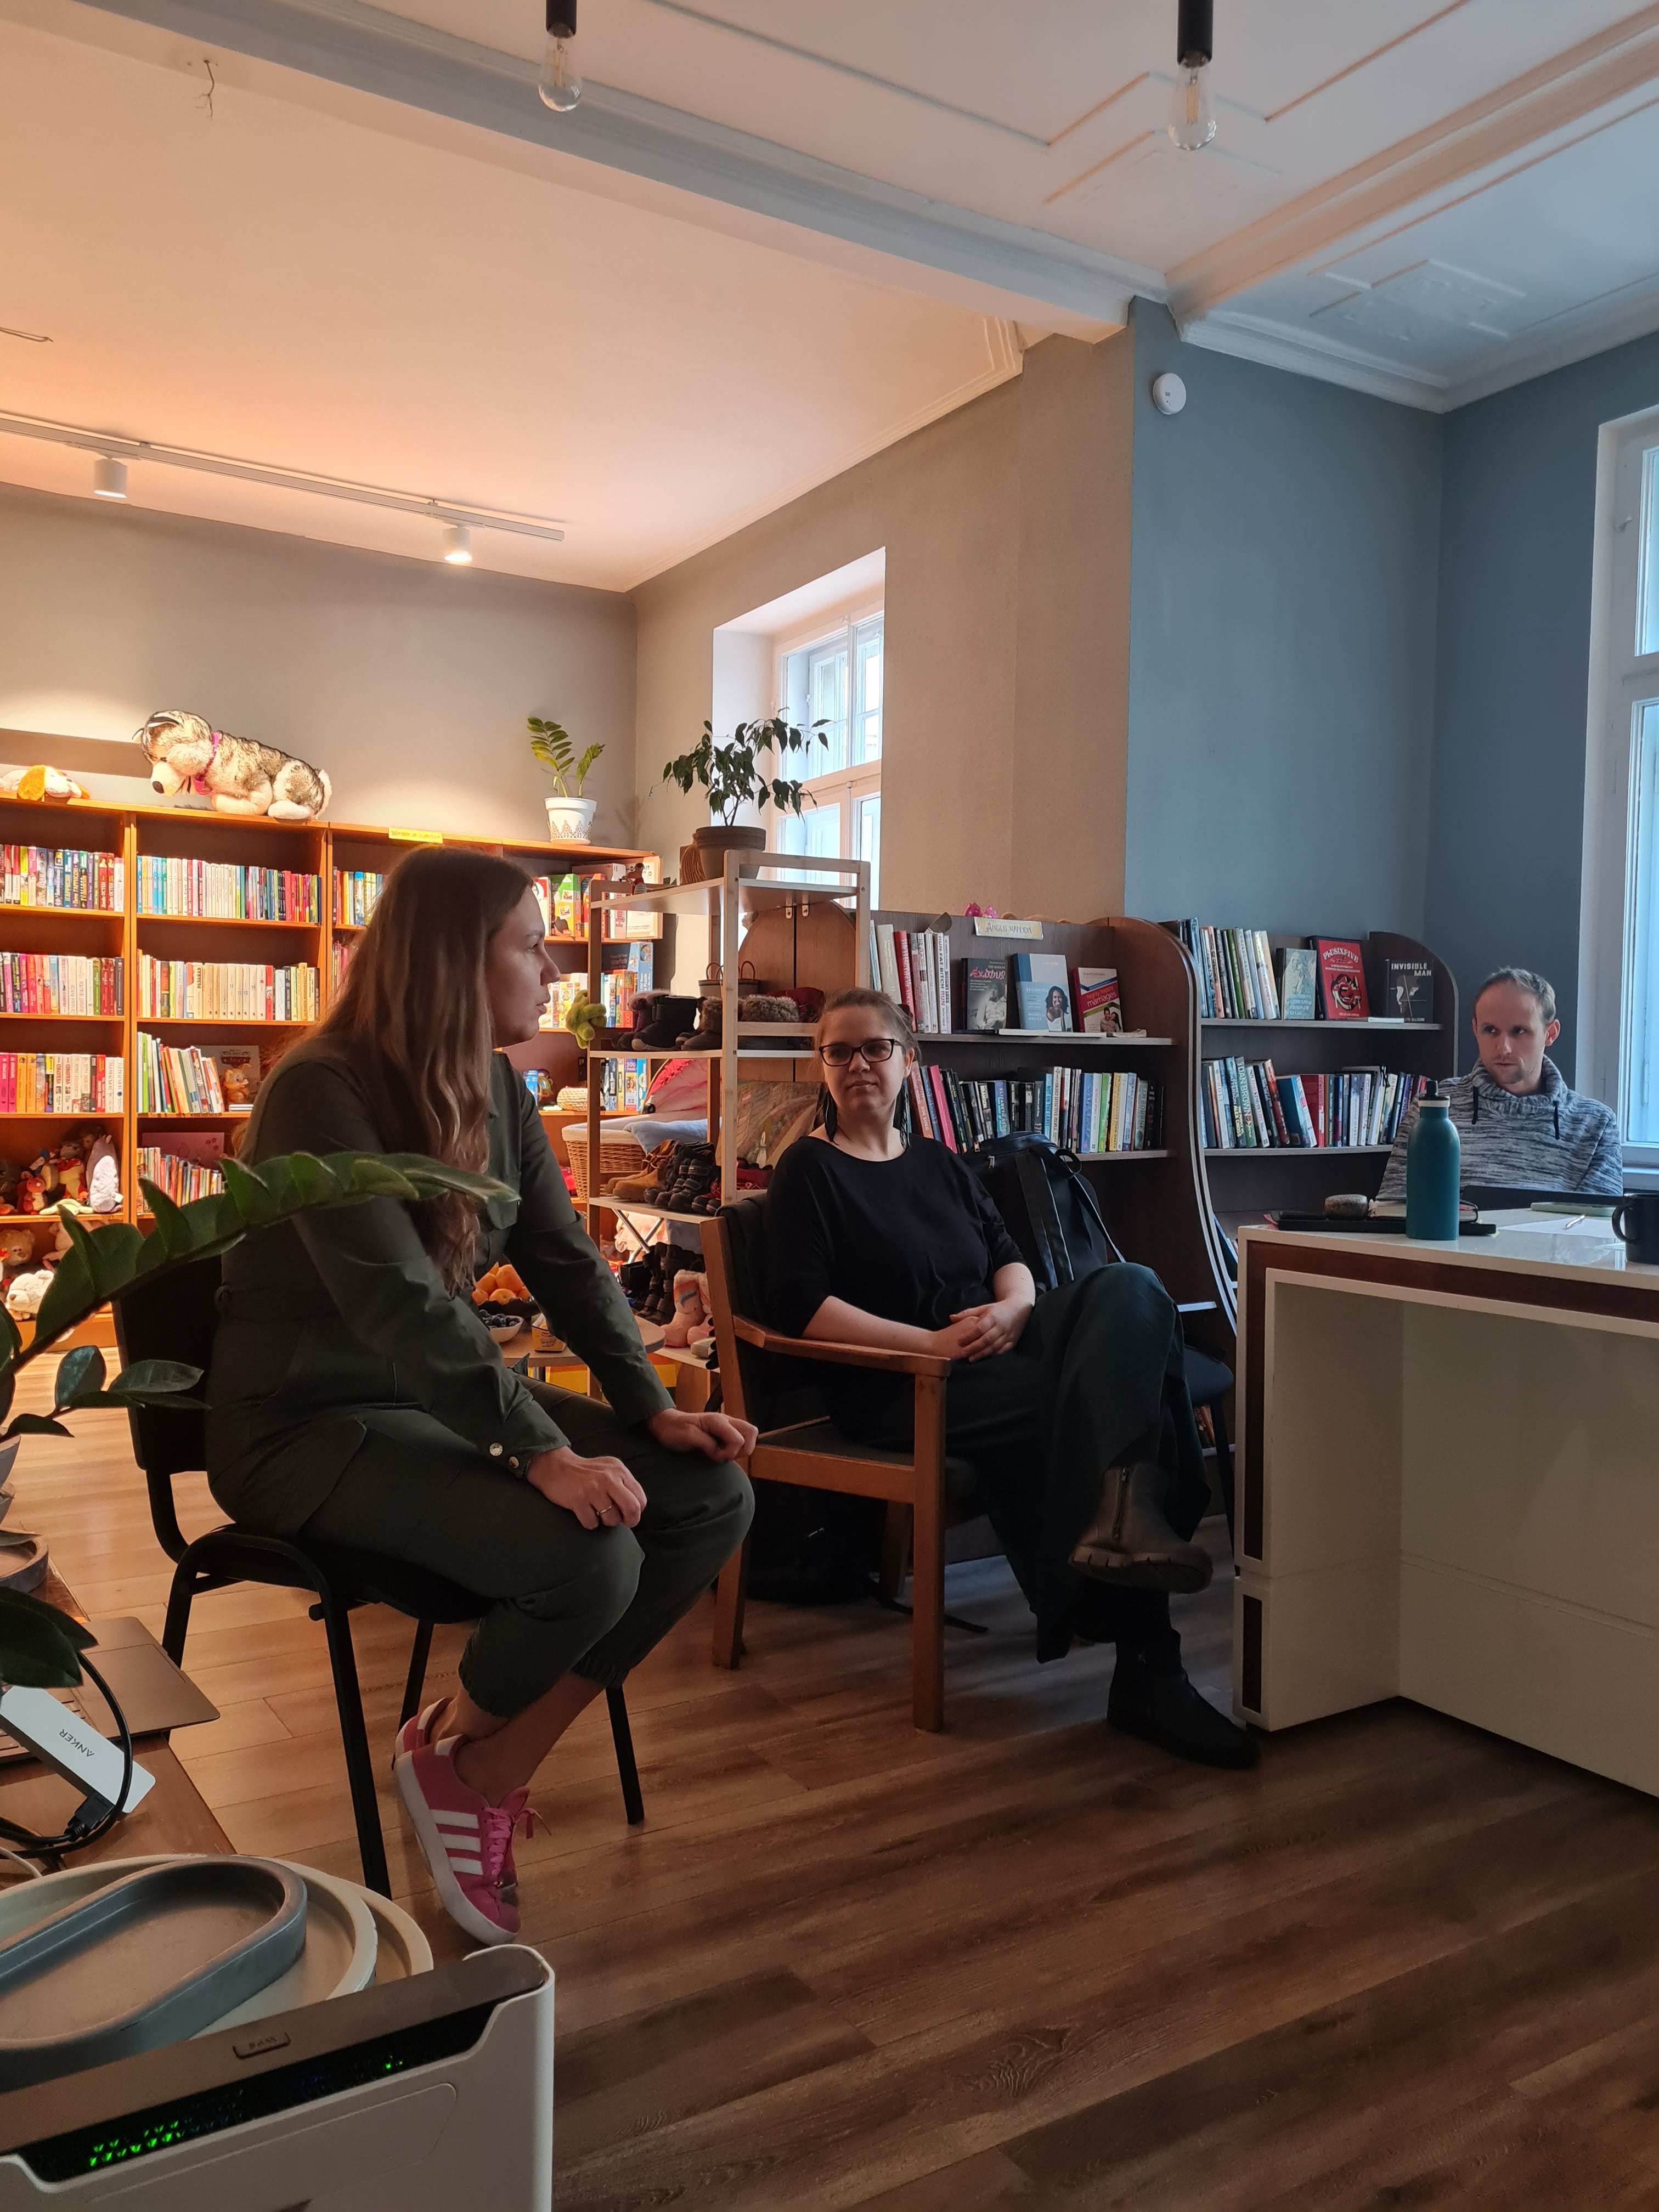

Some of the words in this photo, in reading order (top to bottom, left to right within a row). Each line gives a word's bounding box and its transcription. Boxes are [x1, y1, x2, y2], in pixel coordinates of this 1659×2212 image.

[1087, 991, 1117, 1007] marriages
[1229, 1071, 1237, 1104] PATTERSON
[1237, 1065, 1246, 1084] DAN
[979, 1085, 988, 1108] BRANSON
[1239, 1084, 1251, 1116] BROWN
[59, 1729, 95, 1758] ANKER
